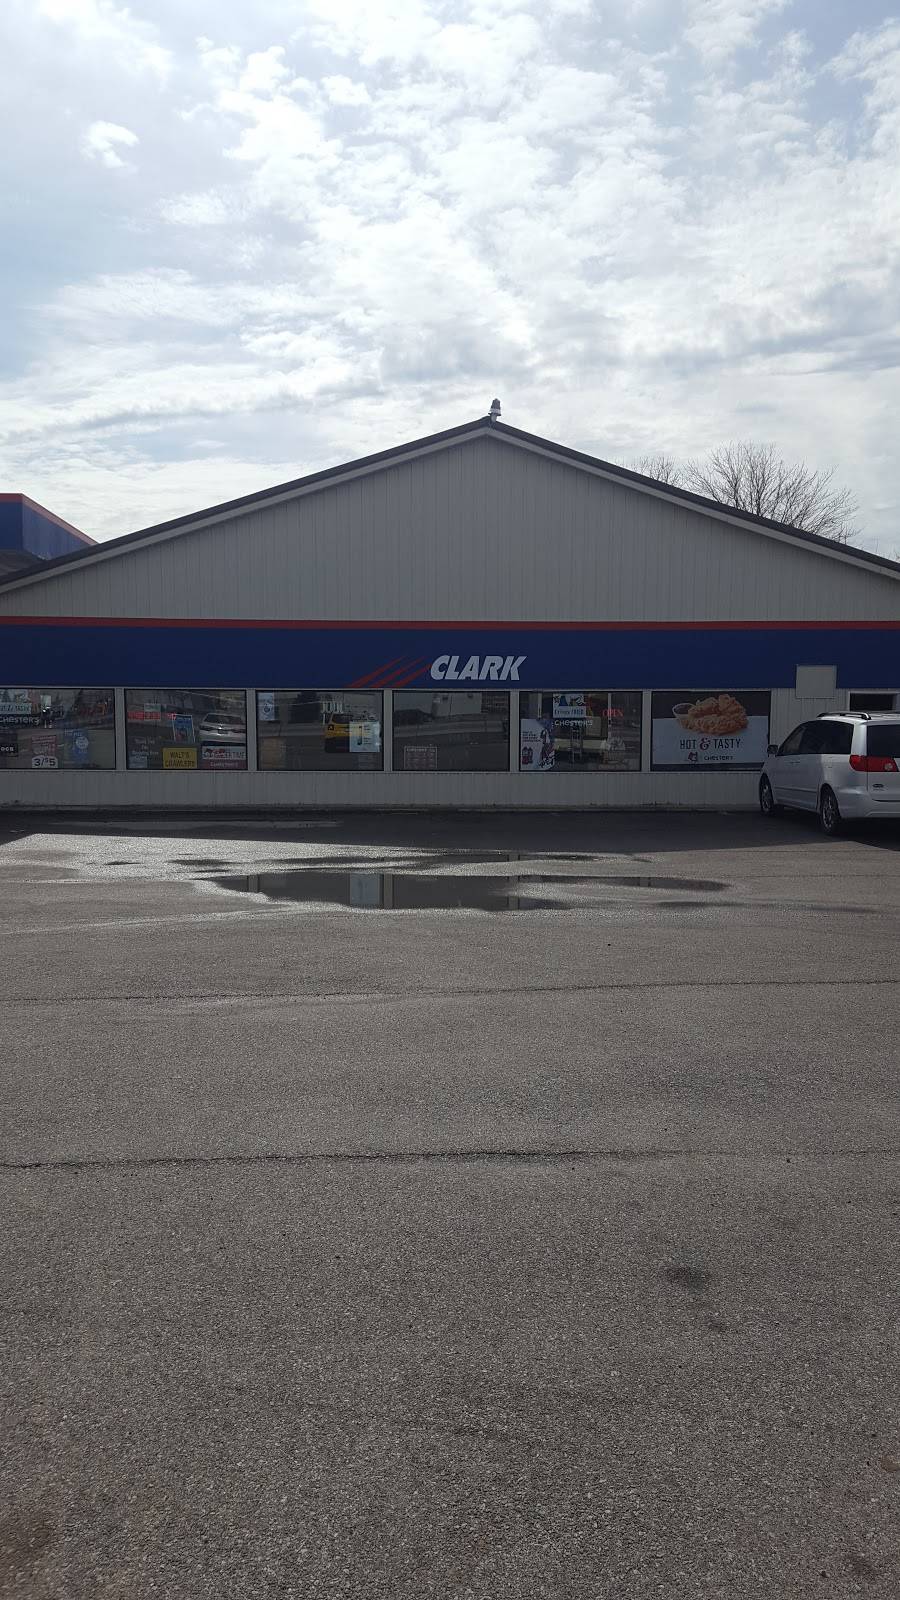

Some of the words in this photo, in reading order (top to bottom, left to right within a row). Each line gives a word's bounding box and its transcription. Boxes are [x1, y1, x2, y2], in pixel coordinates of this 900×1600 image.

[430, 655, 528, 681] CLARK
[602, 708, 624, 718] OPEN
[680, 739, 696, 750] HOT
[699, 737, 711, 751] &
[713, 738, 741, 749] TASTY
[33, 757, 56, 767] 3/$5
